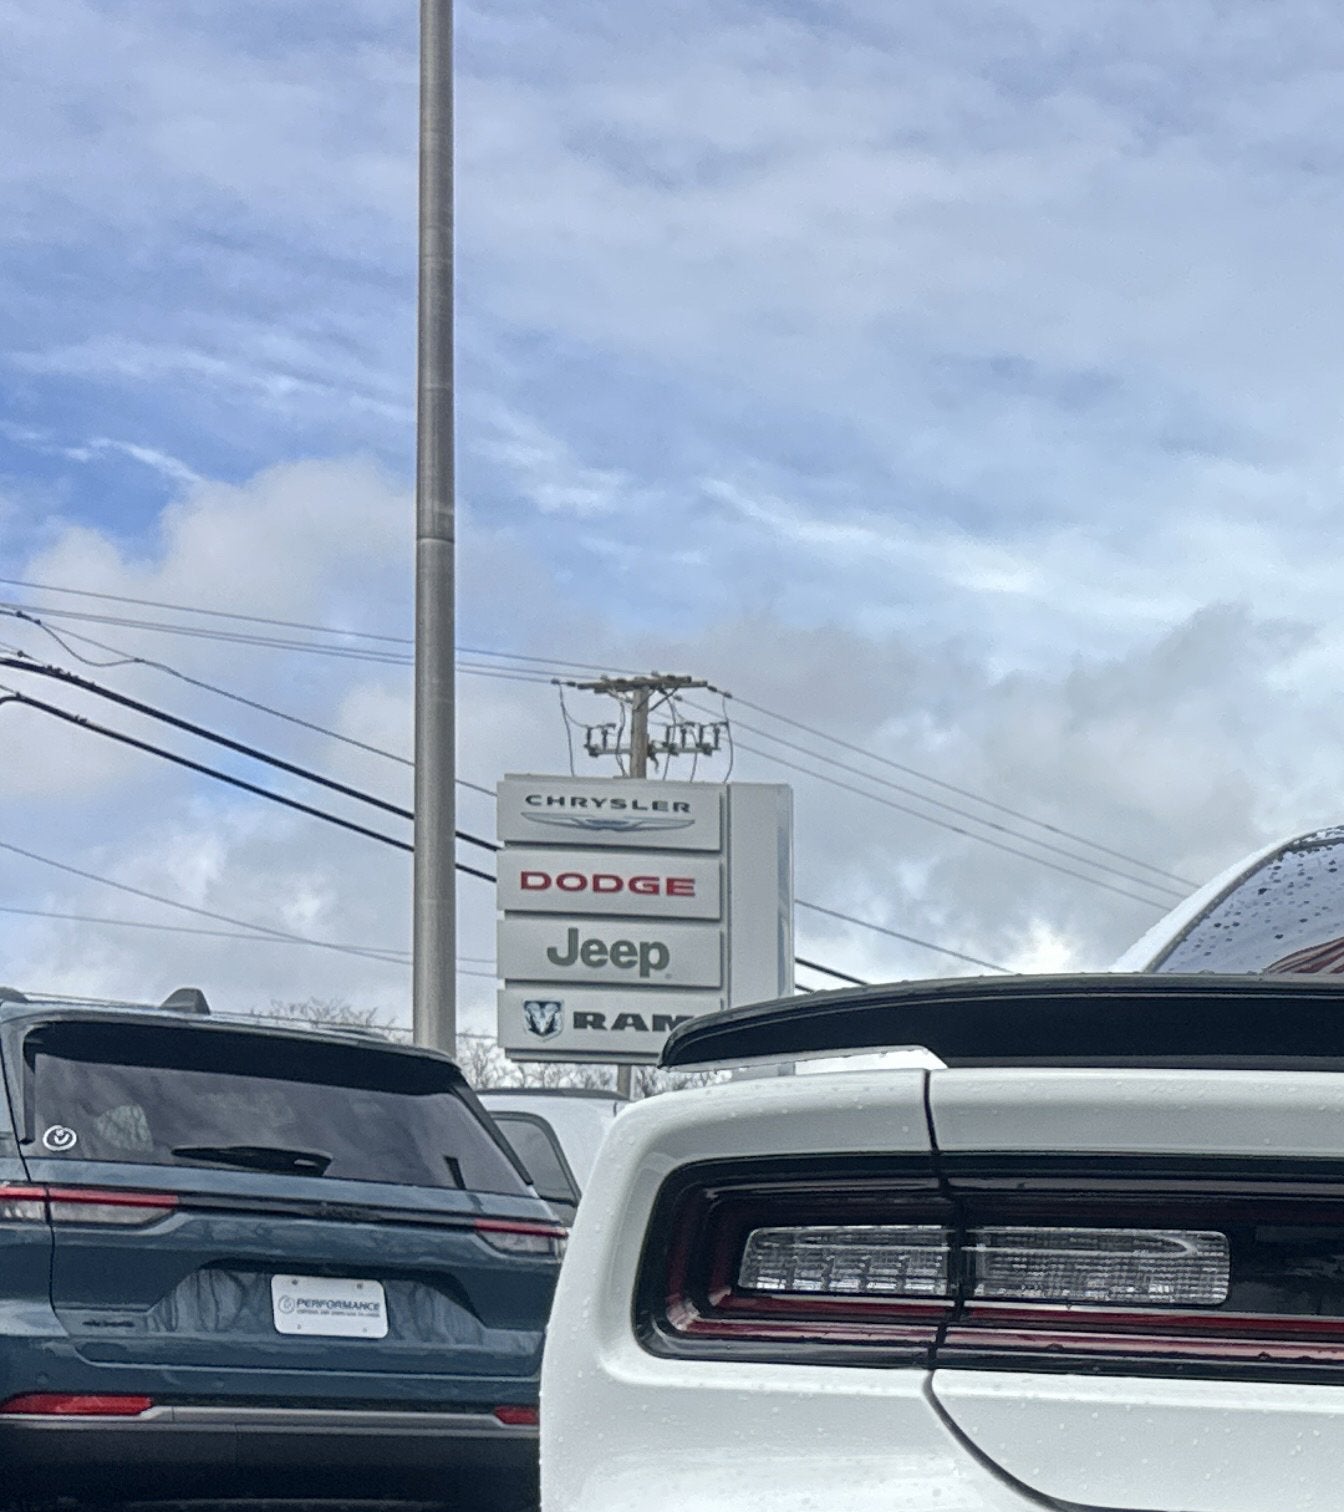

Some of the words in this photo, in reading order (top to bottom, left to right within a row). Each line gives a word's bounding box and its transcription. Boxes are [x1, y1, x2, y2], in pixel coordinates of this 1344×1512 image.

[525, 794, 692, 814] CHRYSLER
[520, 870, 697, 897] DODGE
[546, 927, 671, 979] Jeep
